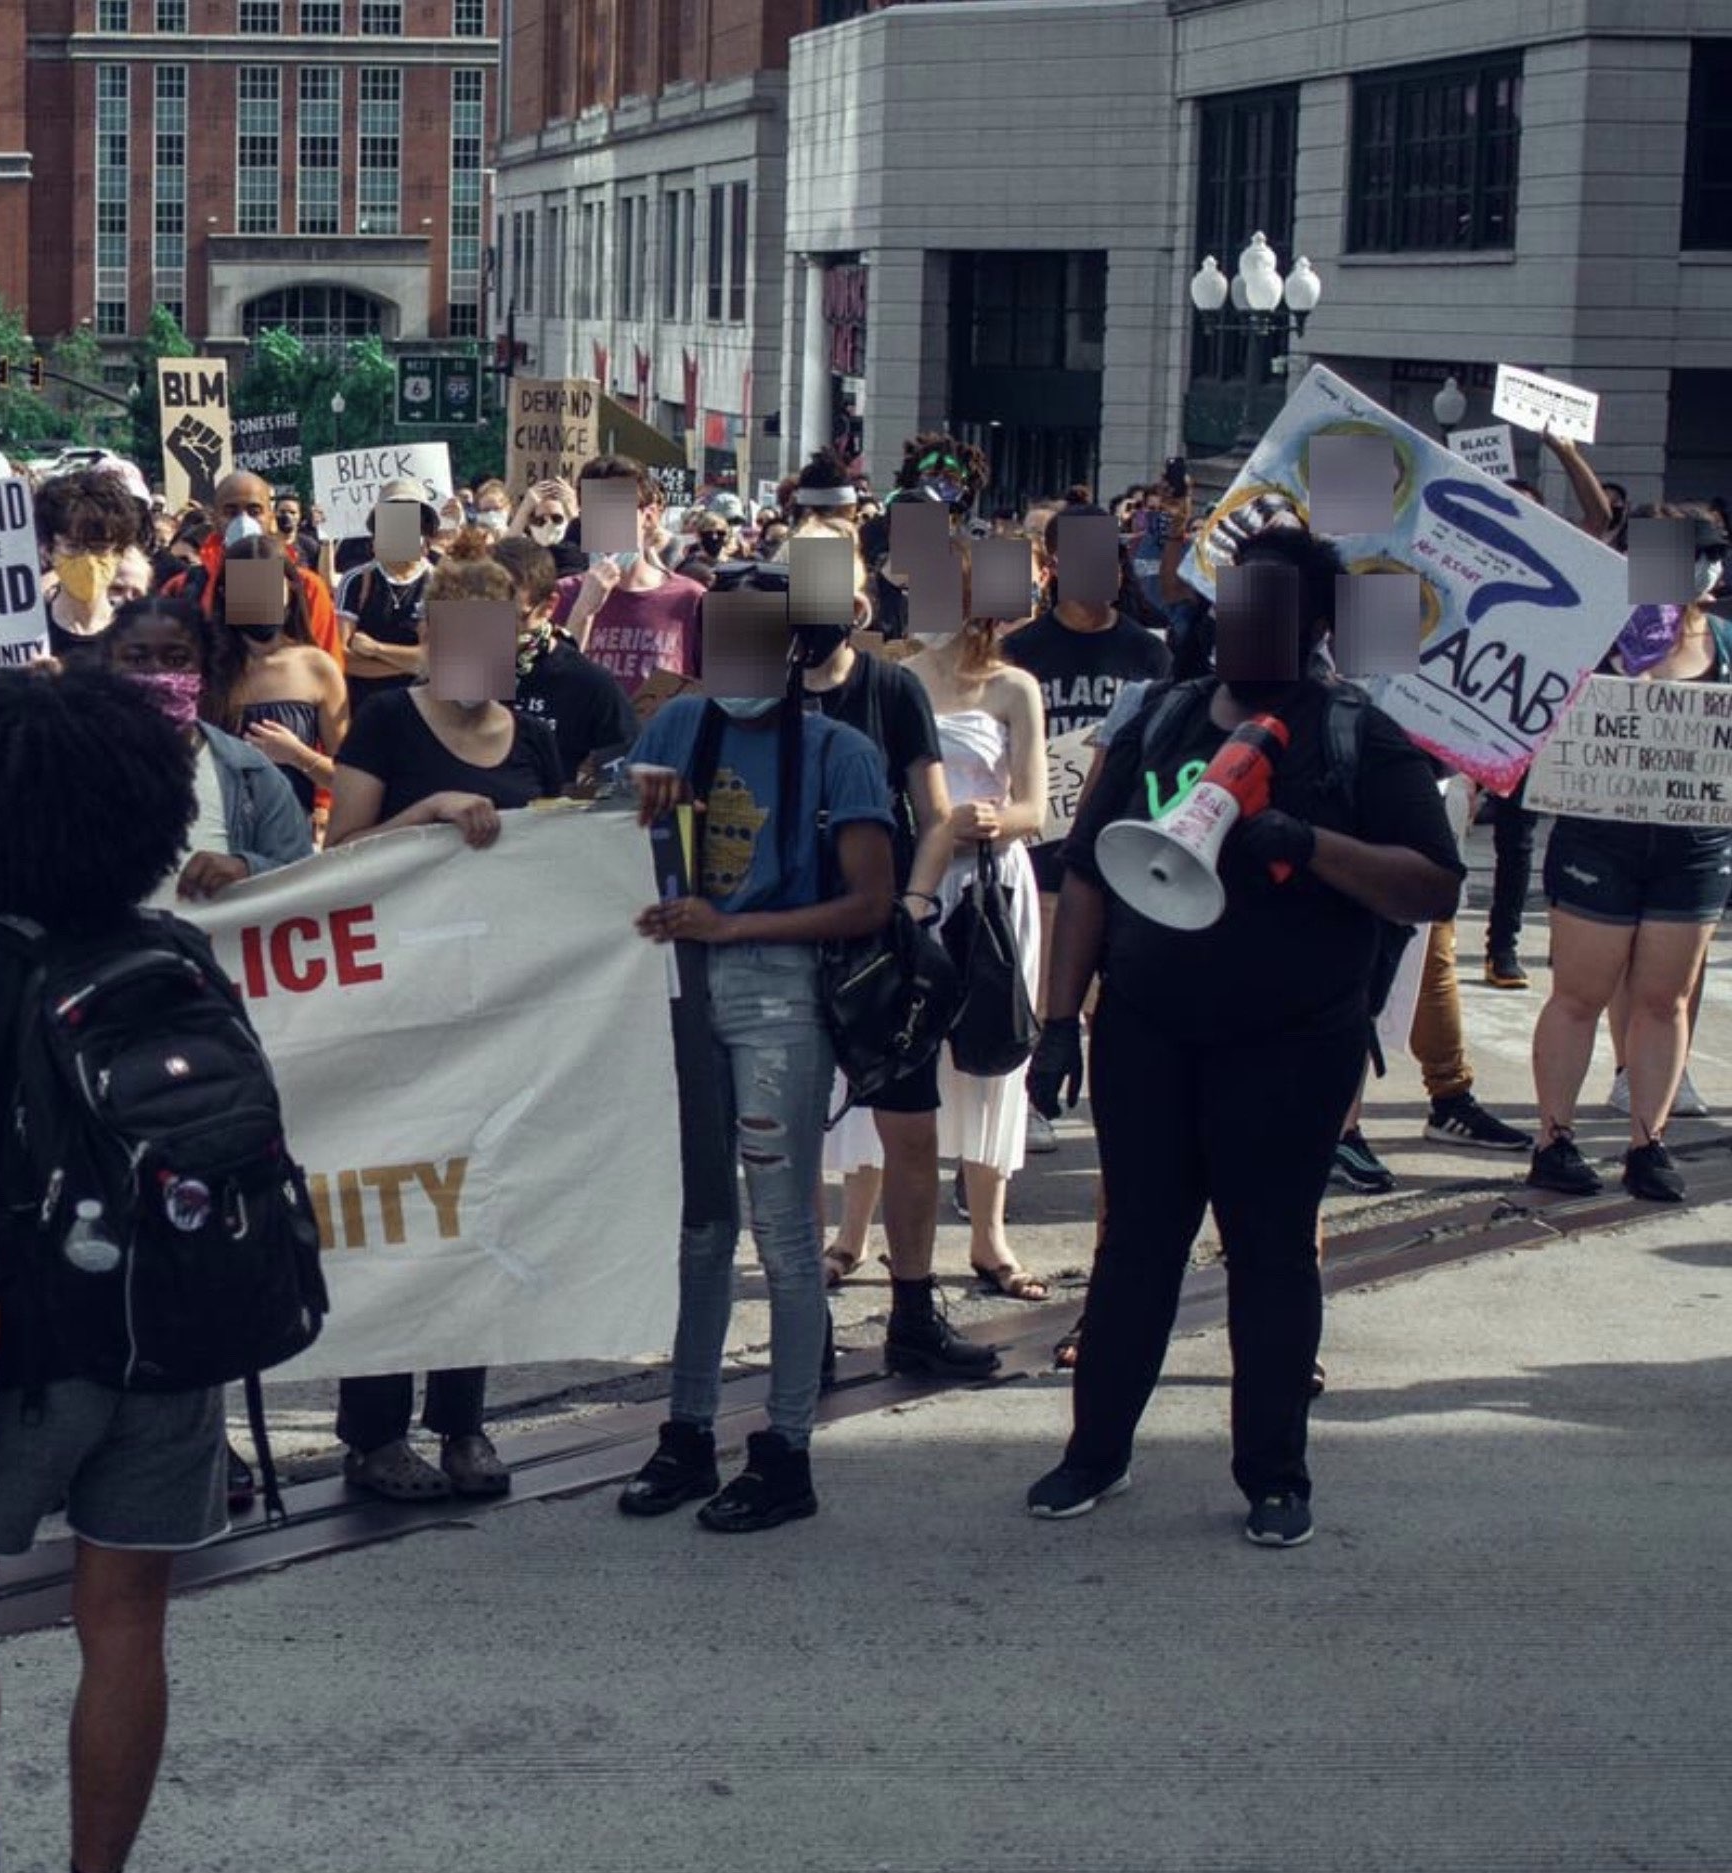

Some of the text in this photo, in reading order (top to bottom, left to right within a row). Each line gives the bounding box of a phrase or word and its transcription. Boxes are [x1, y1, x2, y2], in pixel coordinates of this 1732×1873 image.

[162, 371, 226, 408] BLM
[412, 380, 469, 399] 6 95
[522, 389, 593, 420] DEMAND
[515, 424, 589, 456] CHANGE
[1460, 434, 1501, 451] BLACK
[336, 451, 416, 484] BLACK
[330, 478, 437, 507] FUTS
[591, 624, 683, 651] MERICAN
[1419, 627, 1569, 736] ACAB
[1626, 683, 1639, 713] I
[1647, 684, 1699, 715] CAN'T
[1566, 708, 1590, 737] HE
[1595, 712, 1641, 740] KNEE
[1653, 717, 1679, 742] ON
[1684, 721, 1714, 746] MY
[1553, 740, 1575, 767] I
[1582, 743, 1637, 769] CAN'T
[1639, 748, 1697, 773] BREATHE
[1553, 770, 1727, 803] THEY GONNA KILL ME
[231, 903, 383, 998] ICE
